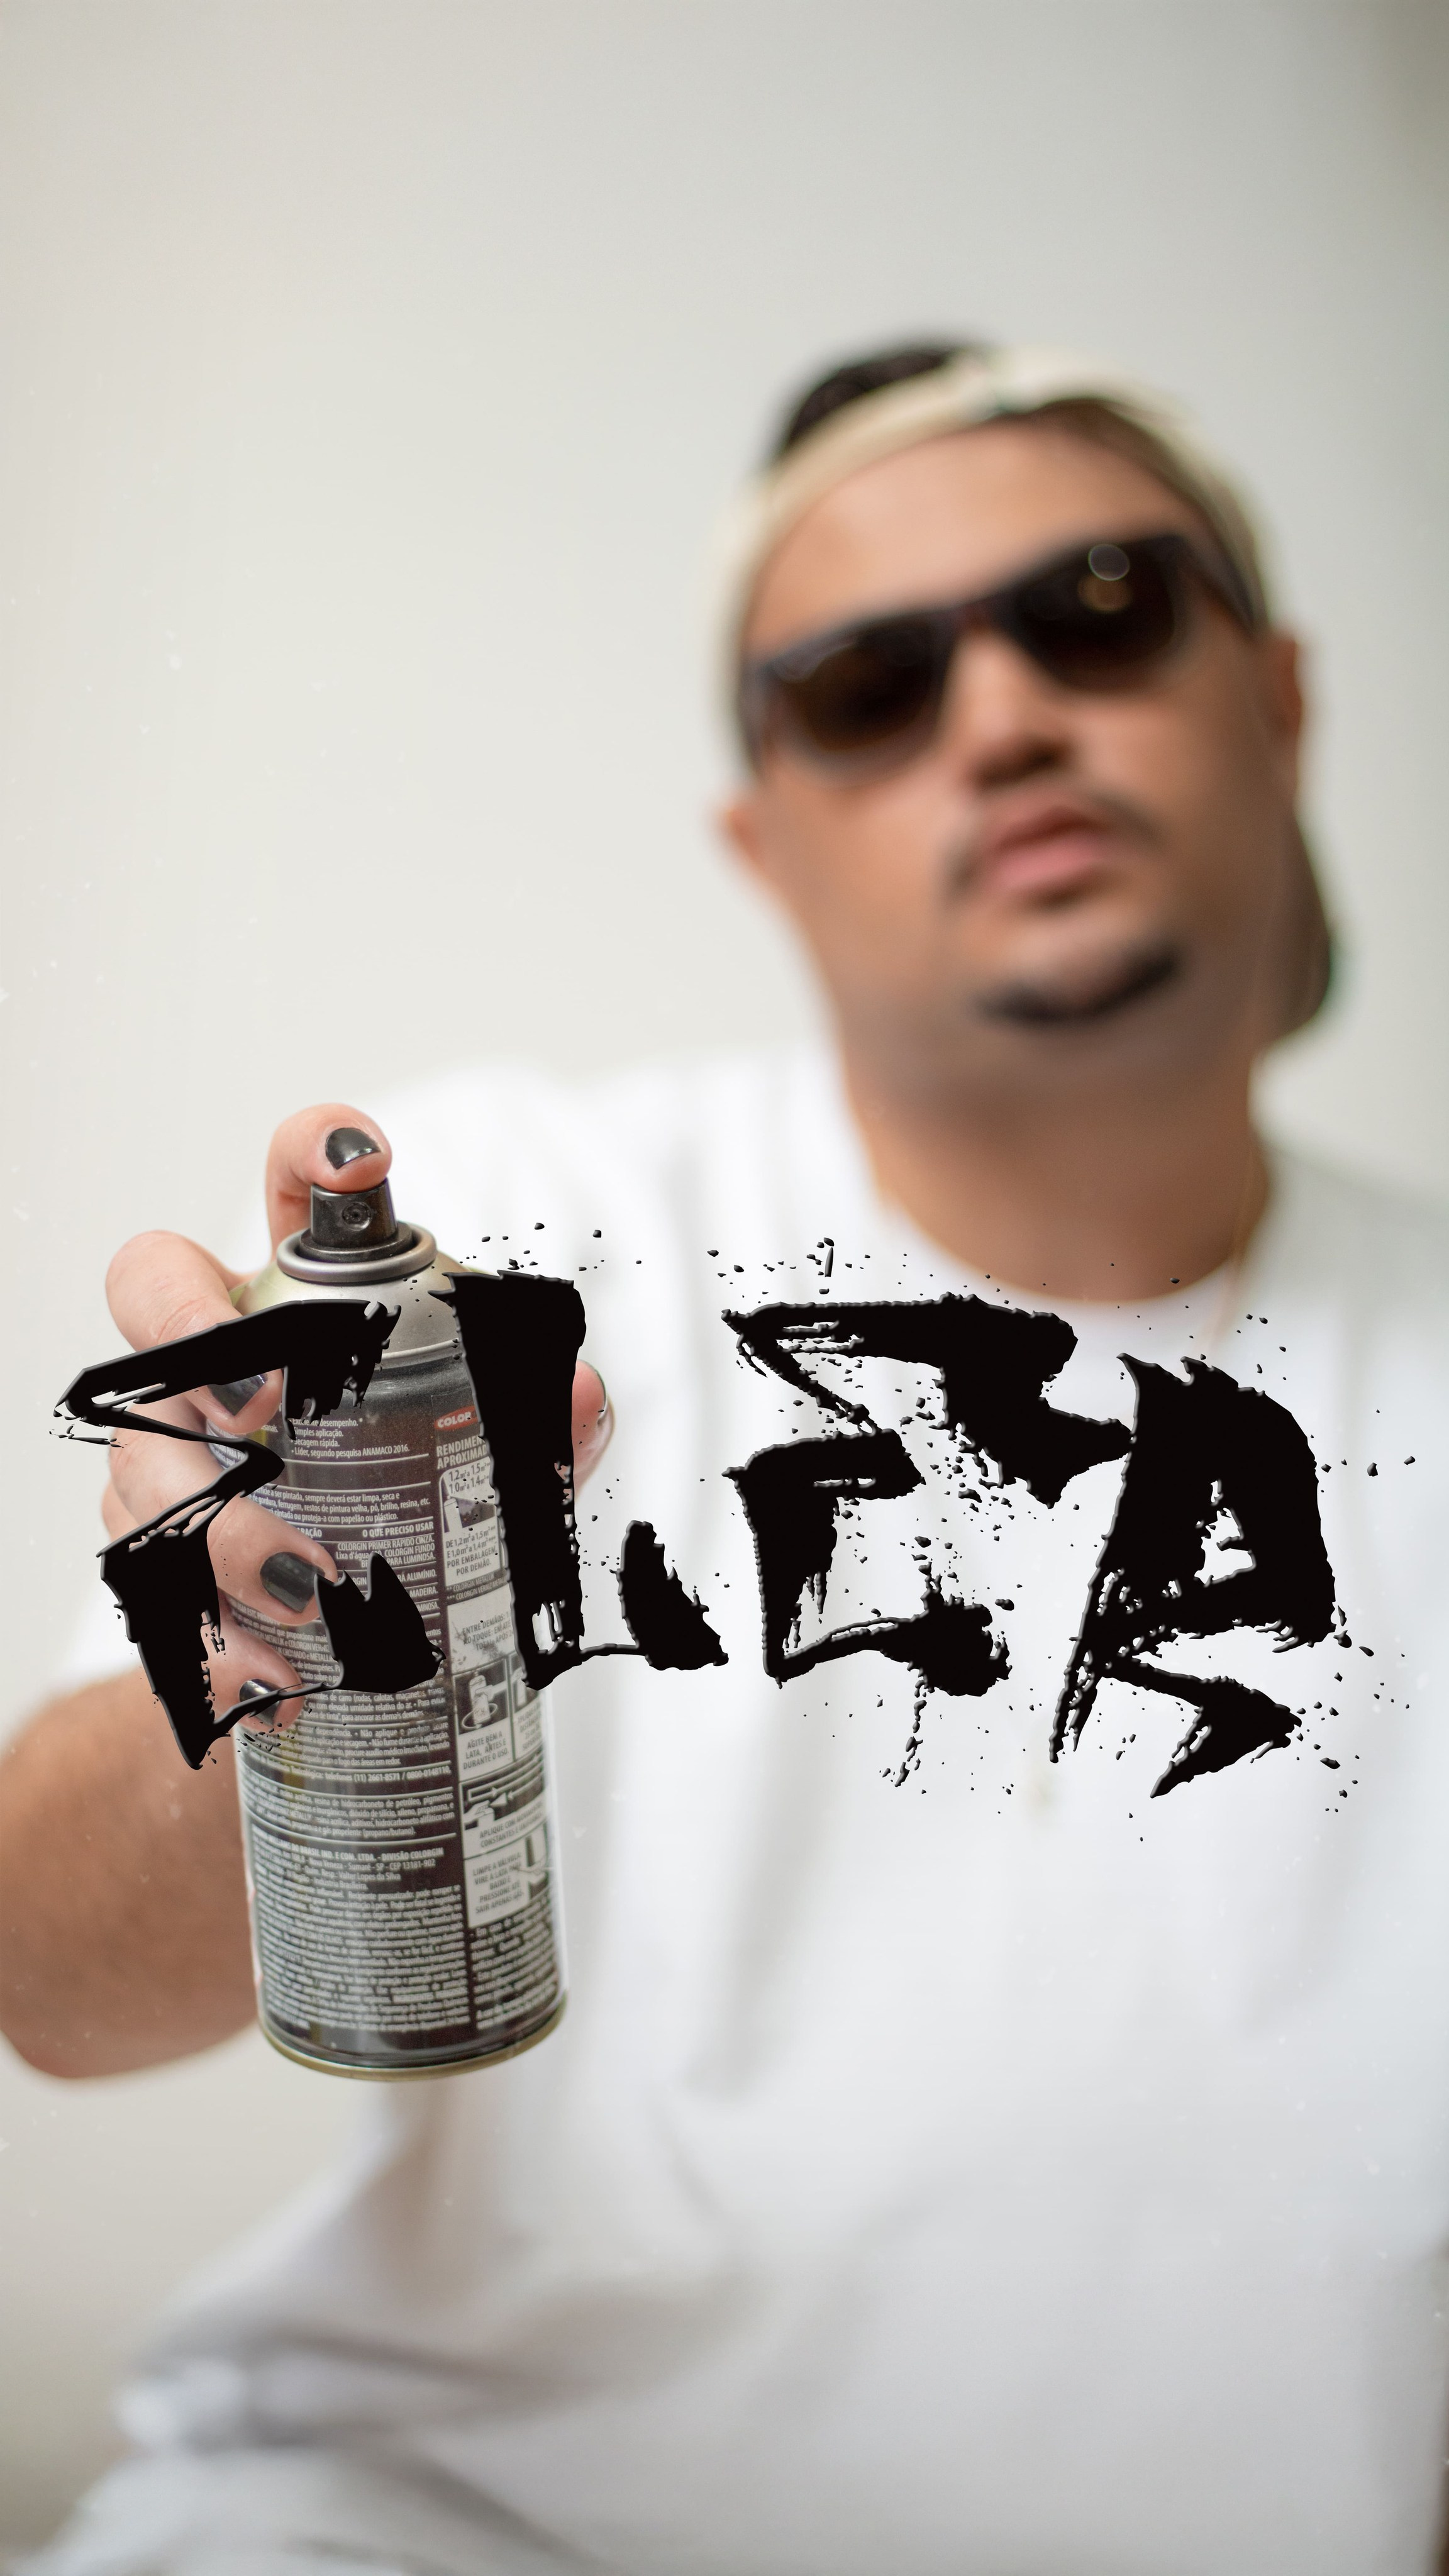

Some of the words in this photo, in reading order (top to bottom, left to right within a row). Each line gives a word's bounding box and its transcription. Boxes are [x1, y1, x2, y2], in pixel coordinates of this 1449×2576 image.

[320, 1418, 358, 1428] desempenho.
[316, 1428, 343, 1438] aplicação.
[319, 1438, 340, 1446] rápida.
[295, 1448, 309, 1457] Líder,
[310, 1450, 335, 1458] segundo
[336, 1449, 361, 1458] pesquisa
[363, 1446, 392, 1456] ANAMACO
[393, 1445, 409, 1453] 2016.
[437, 1444, 487, 1469] APROXIMAD
[258, 1496, 277, 1507] gordura,
[278, 1499, 303, 1511] ferrugem,
[330, 1504, 350, 1513] pintura
[352, 1504, 369, 1513] velha,
[370, 1503, 379, 1513] pó,
[380, 1502, 399, 1511] brilho,
[401, 1500, 419, 1508] resina,
[283, 1492, 304, 1502] pintada,
[305, 1494, 325, 1503] sempre
[326, 1494, 345, 1502] deverá
[362, 1494, 381, 1502] limpa,
[302, 1514, 326, 1523] proteja-a
[341, 1514, 364, 1524] papelão
[374, 1513, 398, 1523] plástico.
[370, 1528, 384, 1538] QUE
[385, 1525, 414, 1536] PRECISO
[416, 1522, 433, 1532] USAR
[338, 1542, 367, 1551] COLORGIN
[368, 1540, 391, 1550] PRIMER
[392, 1538, 414, 1548] RAPIDO
[416, 1535, 435, 1545] CINZA.
[336, 1552, 348, 1560] Lixa
[350, 1551, 369, 1562] d'água
[384, 1546, 414, 1557] COLORGIN
[415, 1543, 435, 1553] FUNDO
[388, 1557, 402, 1565] PARA
[404, 1553, 436, 1563] LUMINOSA.
[447, 1558, 459, 1568] POR
[462, 1546, 497, 1565] EMBALAGEM.
[457, 1567, 468, 1575] POR
[470, 1558, 491, 1572] DEMÃO.
[407, 1569, 436, 1581] ALUMÍNIO.
[409, 1587, 438, 1597] MADEIRA.
[468, 1737, 484, 1749] AGITE
[486, 1733, 497, 1743] BEM
[466, 1750, 482, 1759] LATA,
[485, 1741, 502, 1753] ANTES
[463, 1757, 491, 1769] DURANTE
[498, 1748, 509, 1758] USO.
